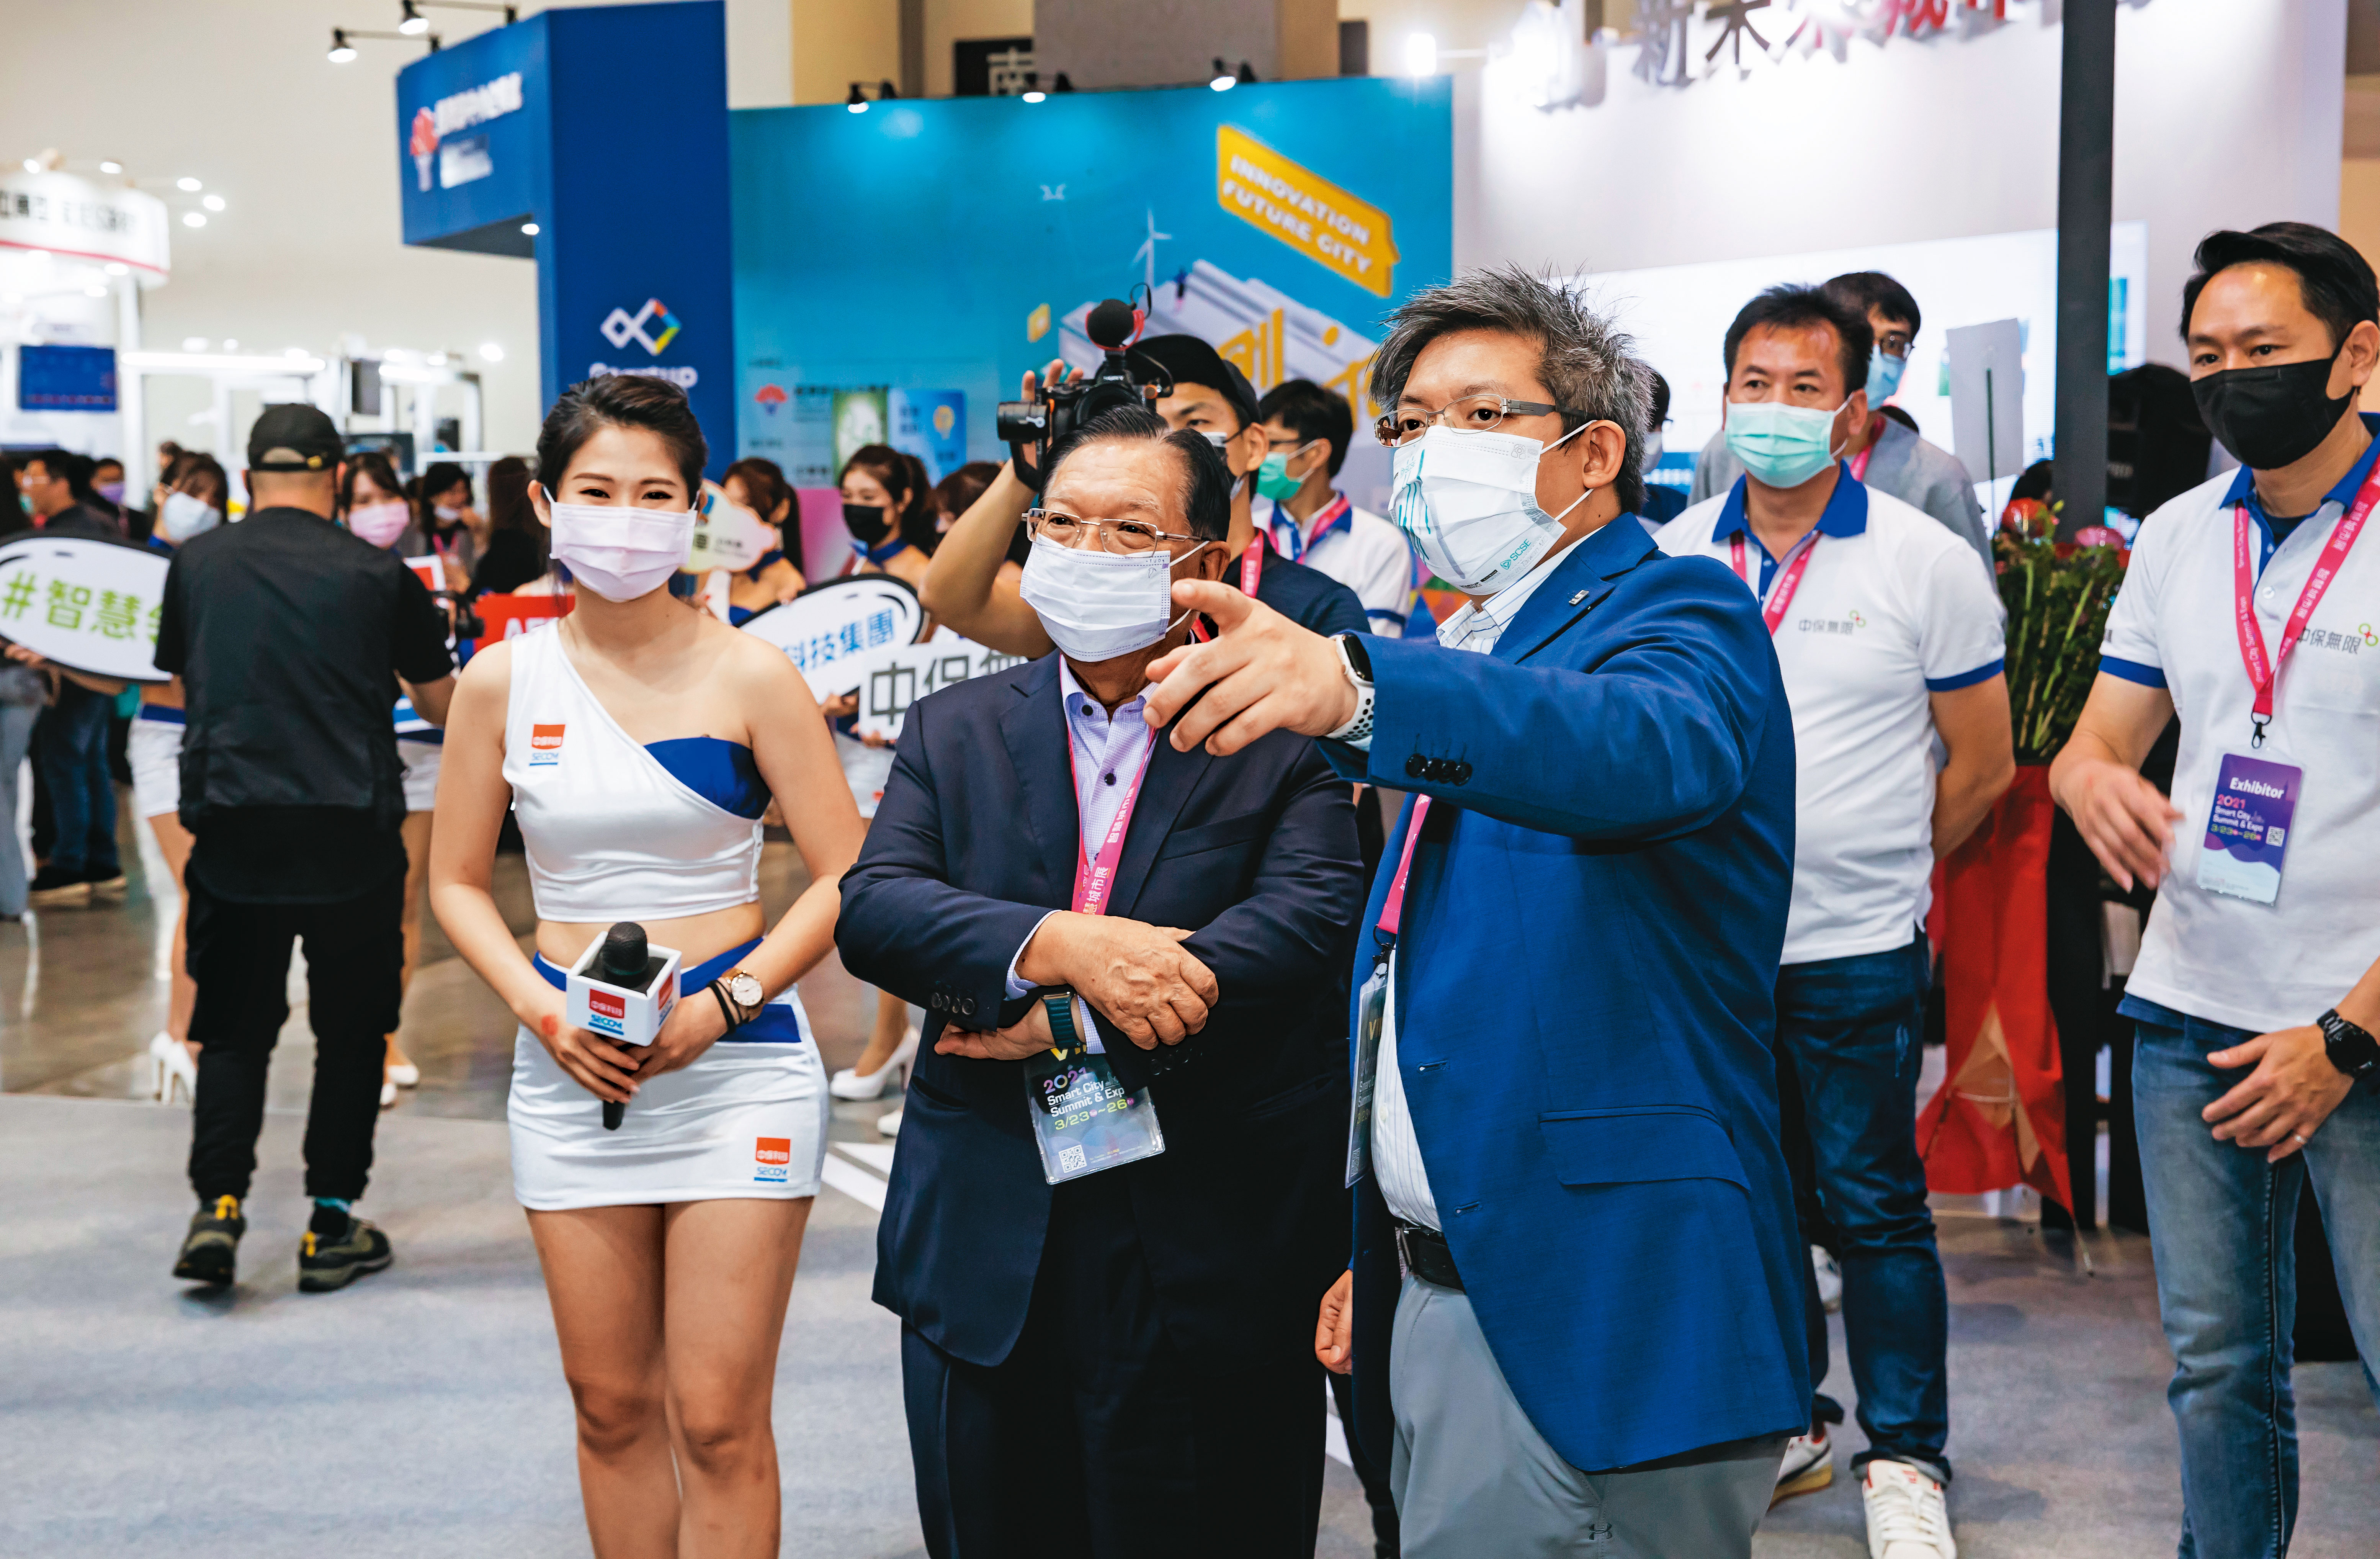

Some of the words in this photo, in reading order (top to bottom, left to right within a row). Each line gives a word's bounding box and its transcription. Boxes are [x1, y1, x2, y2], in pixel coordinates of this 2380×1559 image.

[1231, 154, 1370, 245] INNOVATION
[1223, 180, 1312, 243] FUTURE
[1317, 234, 1372, 274] CITY
[1510, 539, 1532, 561] SCSE
[2229, 777, 2284, 800] Exhibitor
[2217, 794, 2246, 809] 2021
[1048, 1087, 1082, 1106] Smart
[1082, 1080, 1104, 1093] City
[1050, 1096, 1093, 1117] Summit
[1094, 1092, 1104, 1103] &
[1105, 1087, 1125, 1100] Exp
[1054, 1111, 1089, 1130] 3/23
